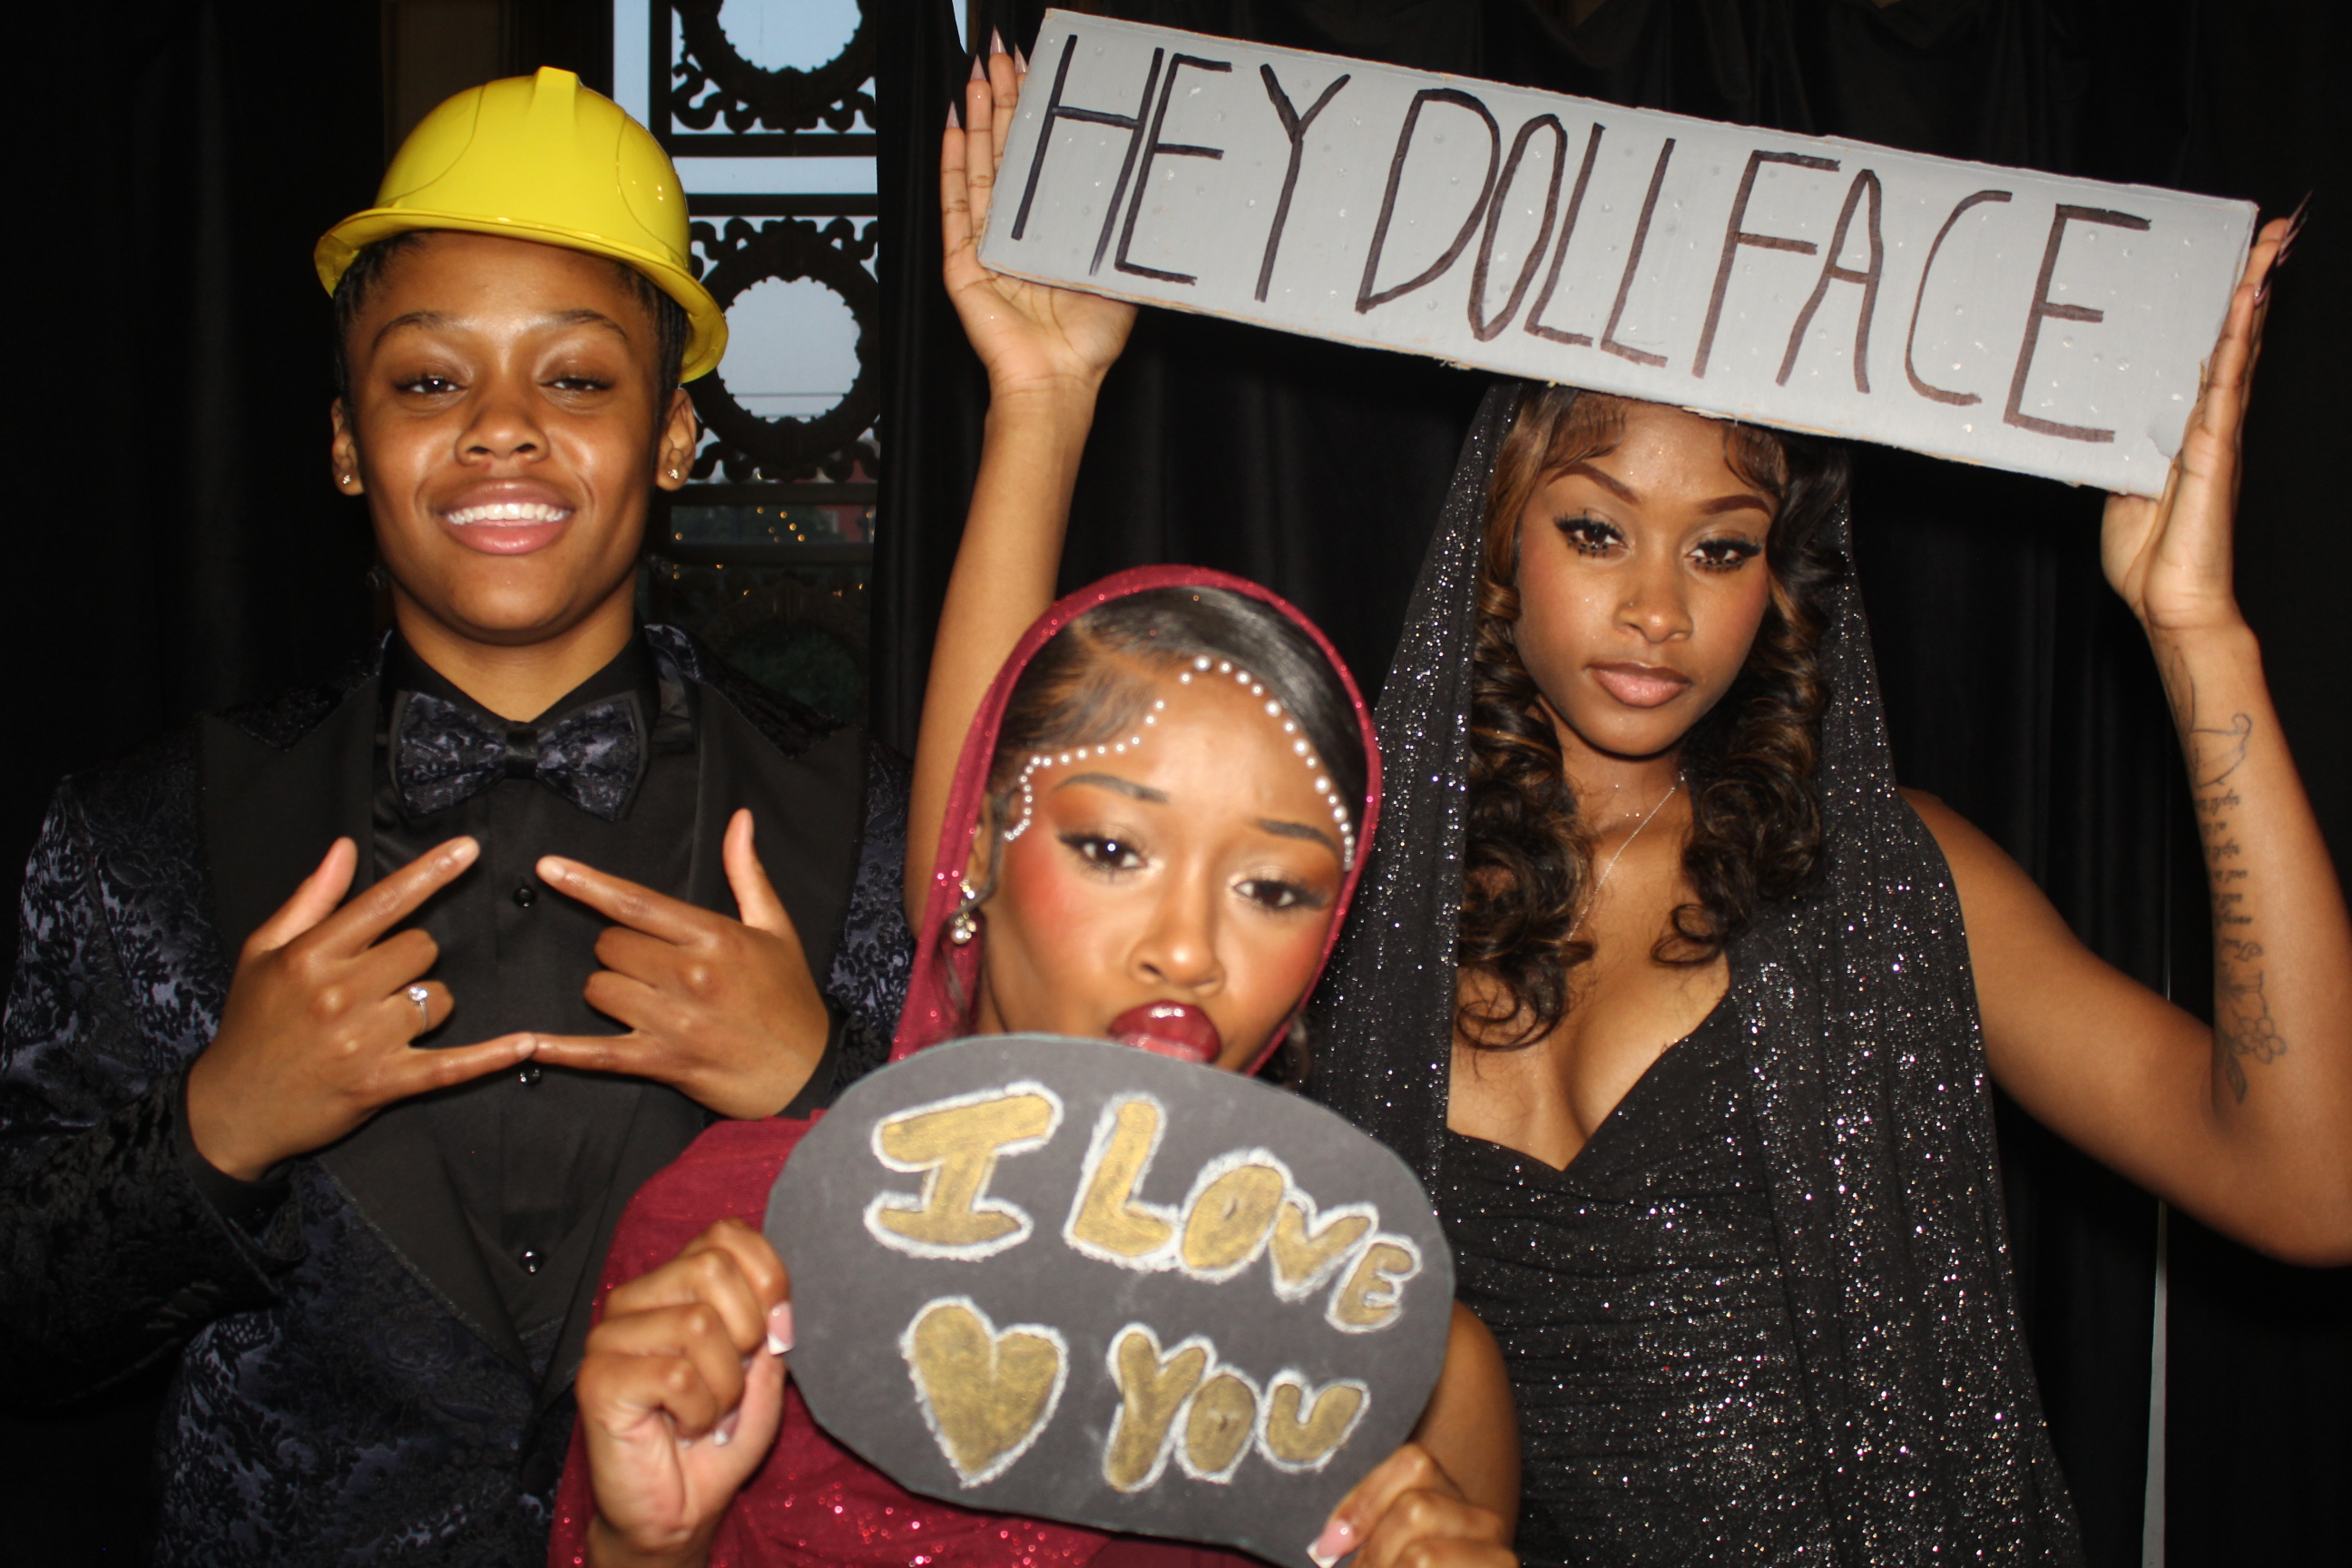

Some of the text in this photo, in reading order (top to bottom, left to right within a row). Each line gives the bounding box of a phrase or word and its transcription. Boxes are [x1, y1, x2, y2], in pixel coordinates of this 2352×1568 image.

[1011, 34, 1352, 303] HEY
[863, 1080, 1064, 1261] I
[1103, 1322, 1370, 1493] YOU
